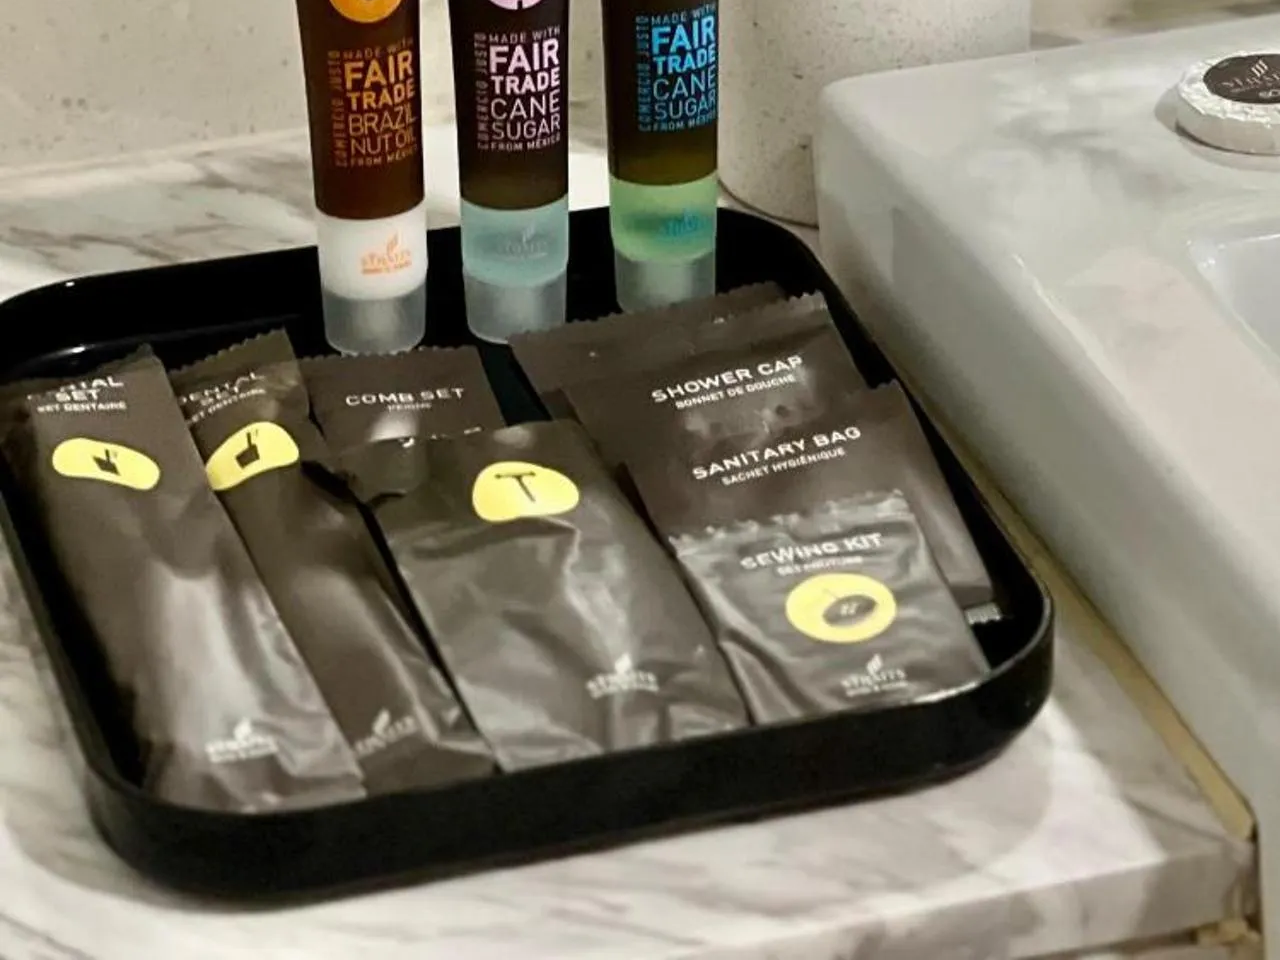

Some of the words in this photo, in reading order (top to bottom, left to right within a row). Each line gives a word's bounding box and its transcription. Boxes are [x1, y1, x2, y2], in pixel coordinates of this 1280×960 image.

[489, 32, 527, 45] MADE
[532, 25, 560, 41] WITH
[651, 12, 688, 25] MADE
[651, 15, 716, 56] FAIR
[344, 50, 414, 90] FAIR
[489, 38, 560, 74] FAIR
[652, 43, 717, 76] TRADE
[346, 78, 416, 111] TRADE
[491, 67, 561, 95] TRADE
[653, 65, 717, 101] CANE
[349, 102, 417, 136] BRAZIL
[490, 89, 561, 120] CANE
[654, 89, 717, 121] SUGAR
[351, 132, 393, 156] NUT
[394, 126, 418, 150] OIL
[492, 114, 561, 141] SUGAR
[490, 141, 523, 152] FROM
[651, 368, 753, 403] SHOWER
[757, 354, 803, 376] CAP
[674, 390, 725, 409] BONNET
[727, 386, 744, 397] DE
[746, 374, 798, 392] DOUCHE
[346, 392, 414, 406] COMB
[420, 388, 464, 401] SET
[692, 439, 806, 479] SANITARY
[812, 426, 862, 447] BAG
[721, 466, 770, 485] SACHET
[740, 542, 840, 570] SEWING
[842, 532, 882, 552] KIT
